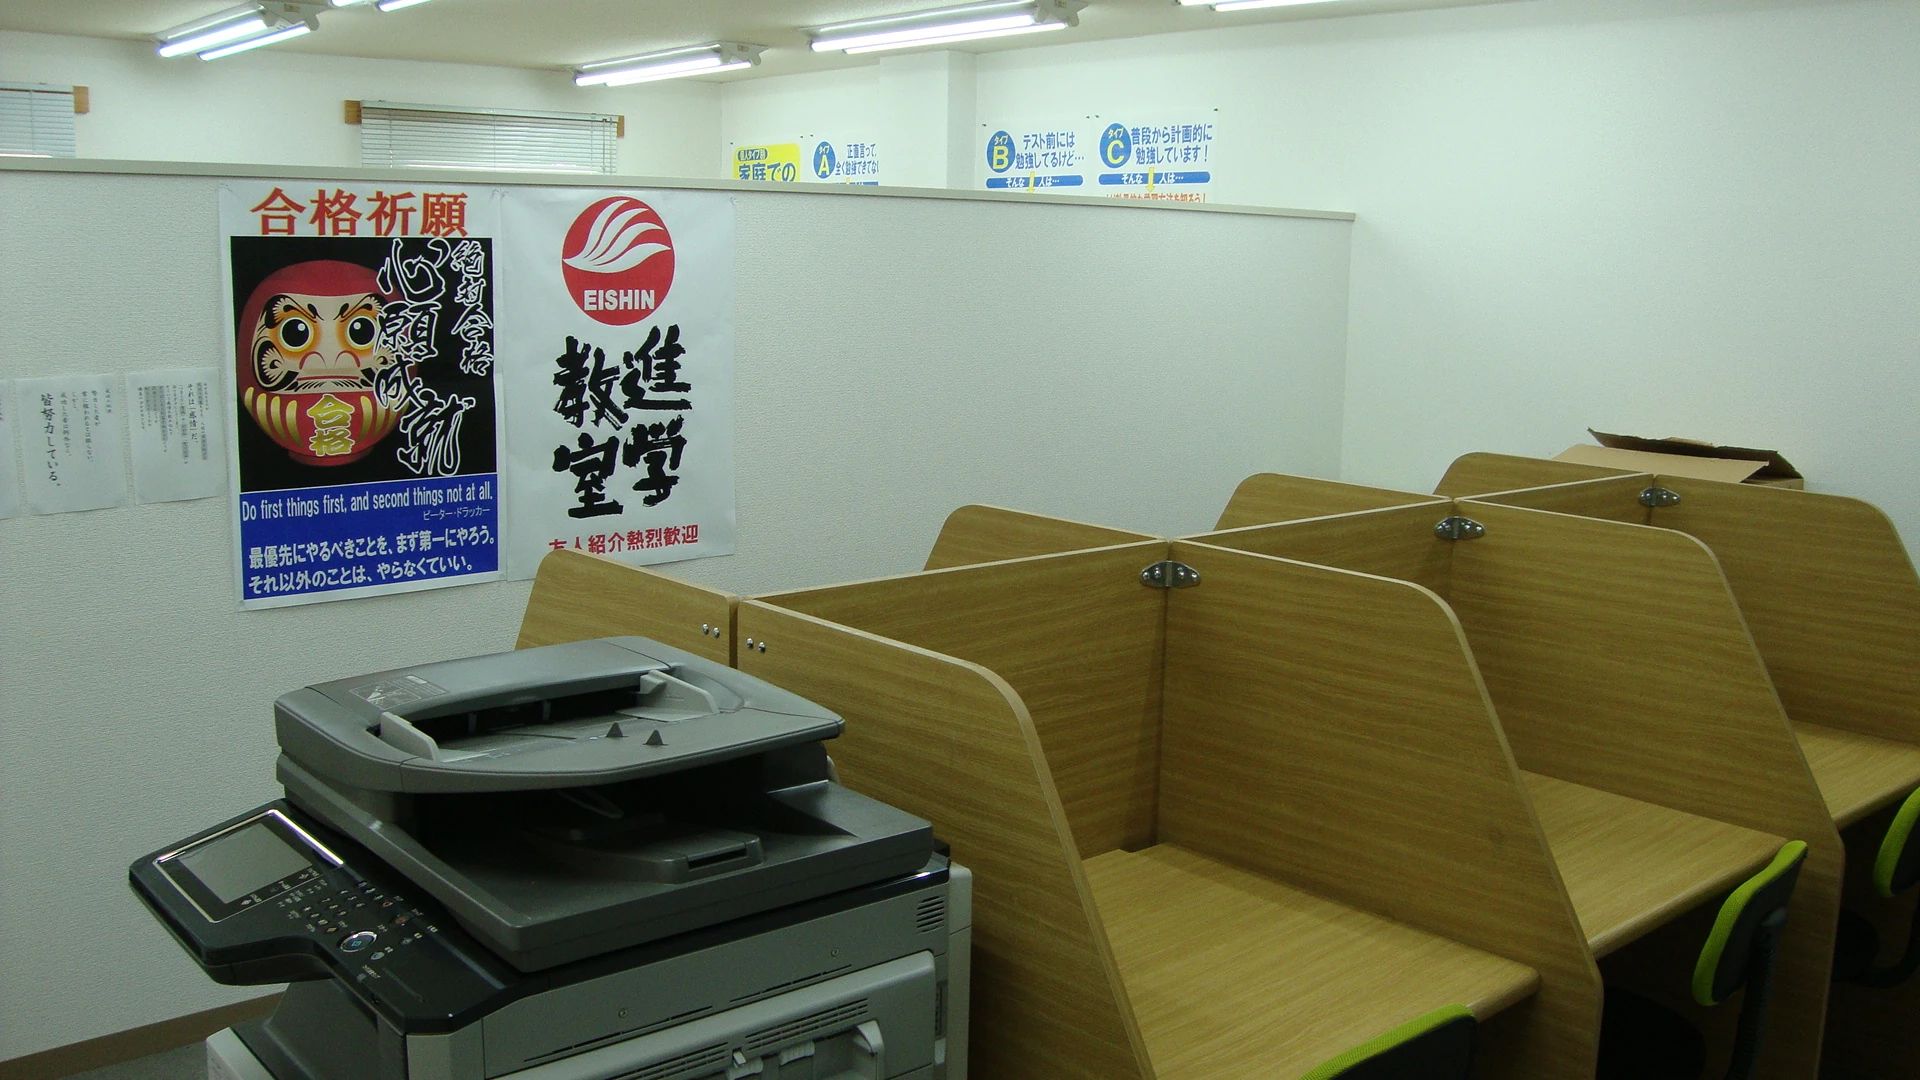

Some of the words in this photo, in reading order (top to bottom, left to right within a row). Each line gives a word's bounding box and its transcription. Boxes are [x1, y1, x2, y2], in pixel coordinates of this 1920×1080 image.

[1023, 131, 1075, 150] テスト前には
[1131, 123, 1213, 145] 普段から計画的に
[818, 154, 830, 176] A
[992, 145, 1009, 170] B
[1107, 140, 1125, 165] C
[1135, 144, 1208, 165] 勉強しています！
[738, 162, 796, 182] 家庭での
[1005, 176, 1025, 188] そんな
[1121, 172, 1143, 185] そんな
[251, 187, 468, 238] 合格祈願
[450, 240, 494, 377] 絶対合格
[583, 289, 655, 311] EISHIN
[373, 238, 477, 477] 心願成就
[306, 393, 356, 457] 合格
[552, 335, 629, 519] 教室
[619, 324, 692, 507] 進学
[242, 501, 257, 521] Do
[260, 499, 283, 520] first
[287, 497, 320, 518] things
[323, 494, 347, 514] first,
[350, 491, 369, 512] and
[373, 488, 410, 509] second
[413, 486, 443, 506] things
[446, 484, 462, 503] not
[465, 483, 475, 502] at
[479, 481, 493, 500] all.
[249, 525, 495, 570] 最優先にやるべきことを、まず第一にやろう。
[249, 555, 473, 595] それ以外のことは、やらなくていい。
